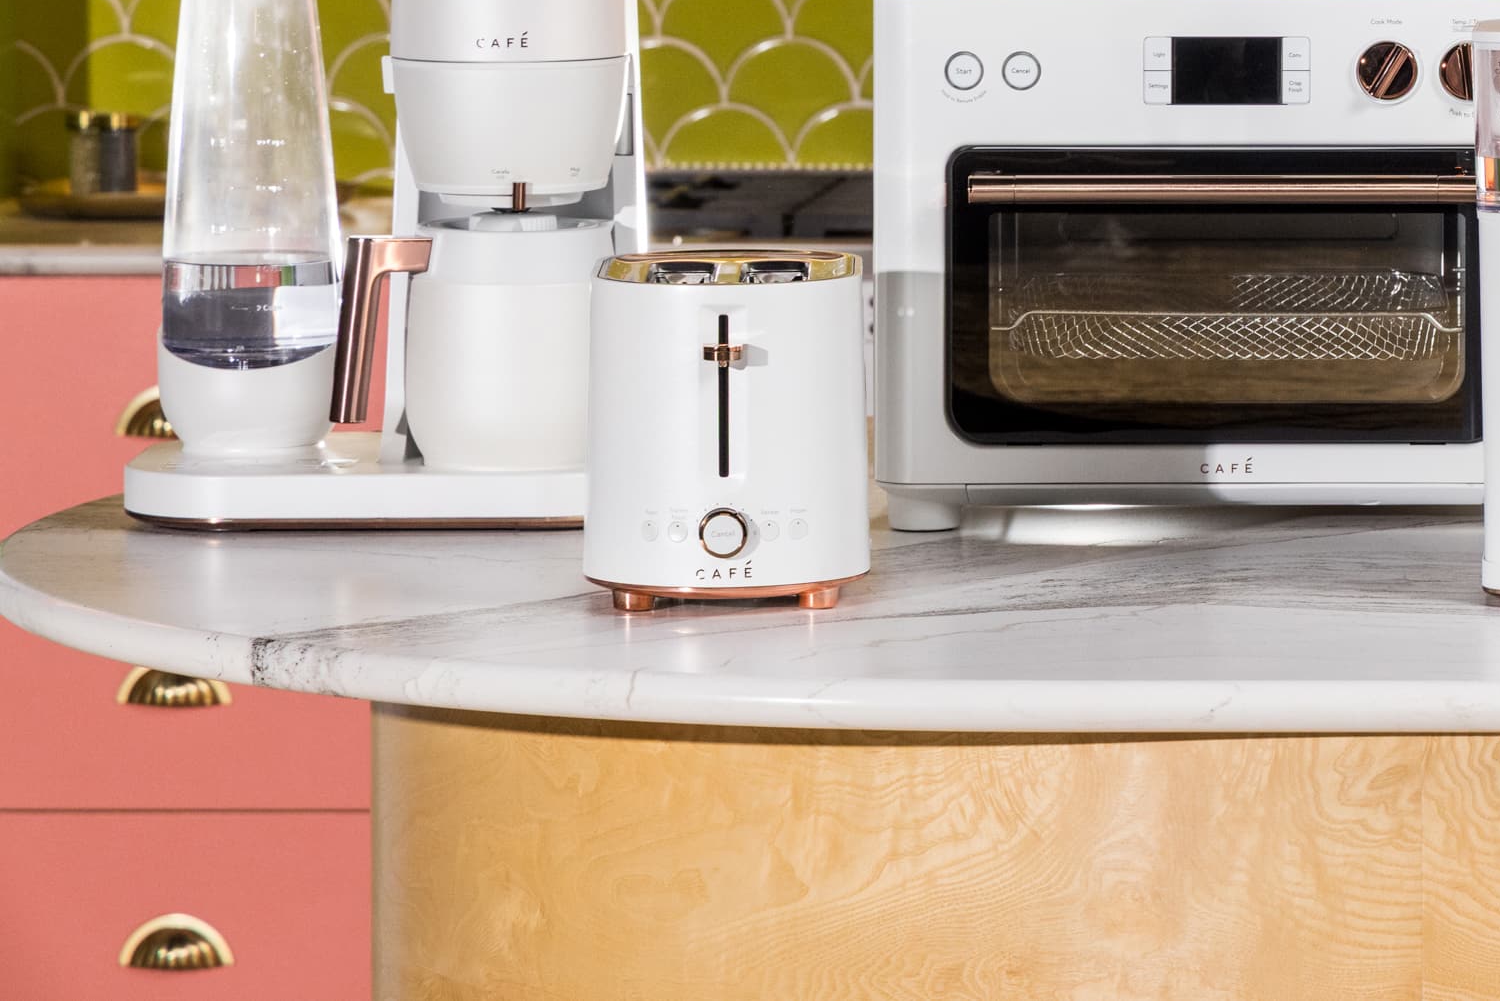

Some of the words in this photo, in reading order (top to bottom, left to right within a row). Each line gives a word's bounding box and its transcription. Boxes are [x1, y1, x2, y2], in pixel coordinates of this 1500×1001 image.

[476, 31, 528, 49] CAFÉ
[955, 67, 973, 75] Start
[1200, 457, 1253, 474] CAFÉ
[696, 560, 753, 580] CAFÉ
